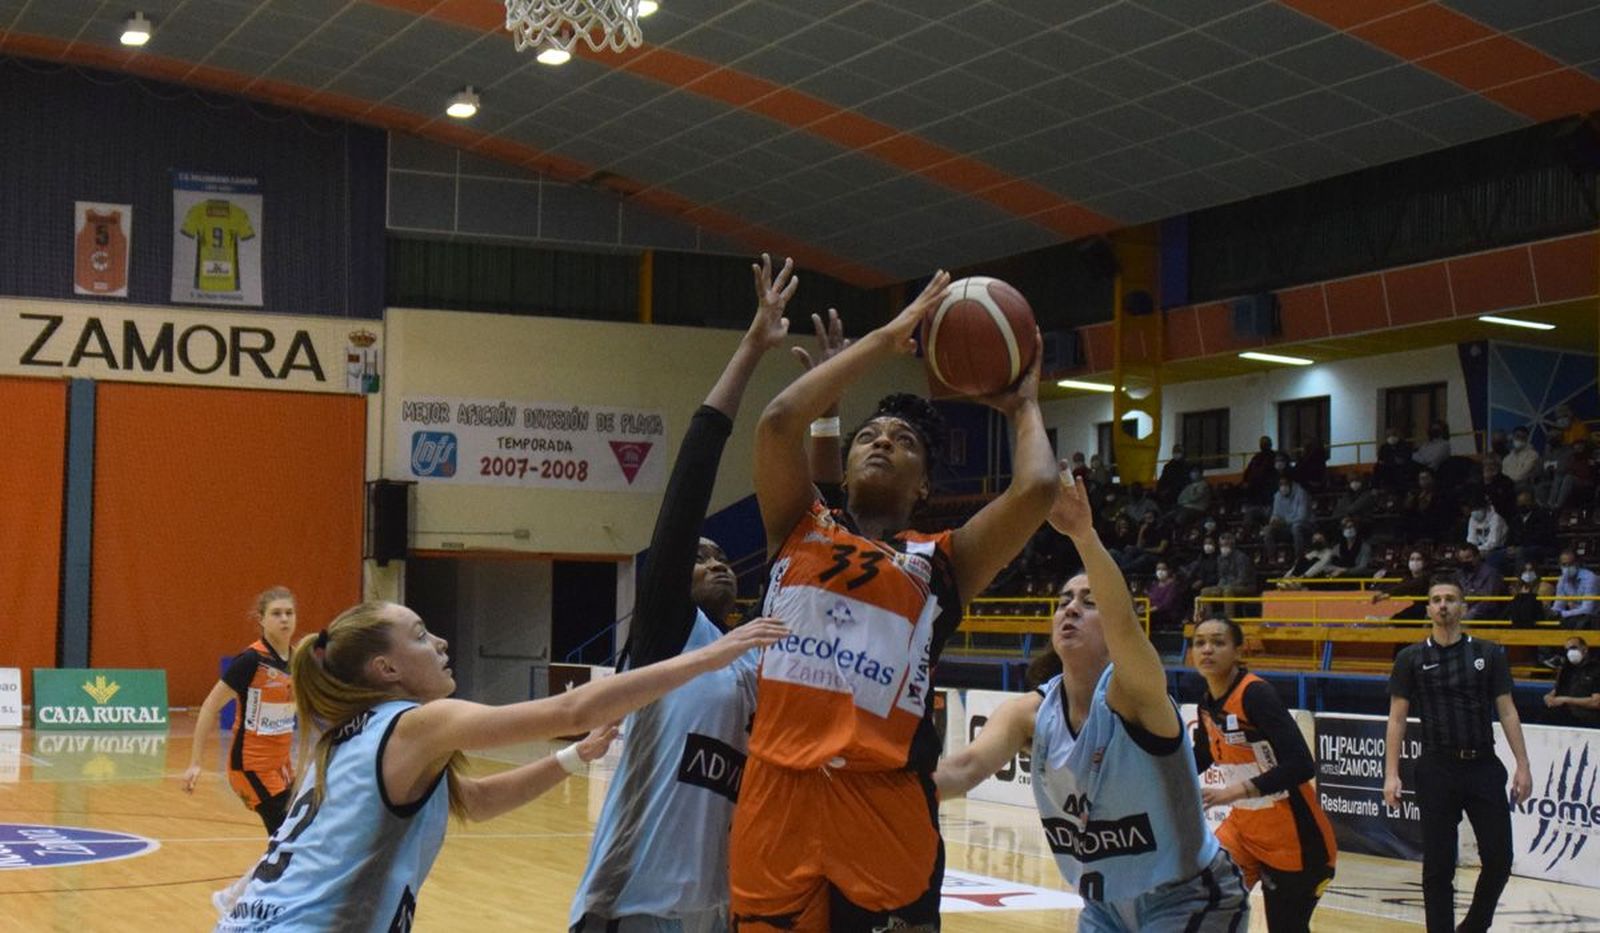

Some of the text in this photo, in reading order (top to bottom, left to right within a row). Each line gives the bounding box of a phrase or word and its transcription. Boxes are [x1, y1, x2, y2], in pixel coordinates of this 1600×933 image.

[212, 227, 223, 248] 9
[19, 313, 326, 382] ZAMORA
[402, 401, 663, 435] MEJOR AFICIÓN DIVISIÓN DE PLATA
[497, 437, 573, 452] TEMPORADA
[480, 456, 588, 482] 2007-2008
[819, 544, 885, 590] 33
[39, 706, 166, 724] CAJA RURAL
[1340, 737, 1385, 757] PALACIO
[1340, 758, 1383, 778] ZAMORA
[1320, 793, 1379, 817] Restaurante
